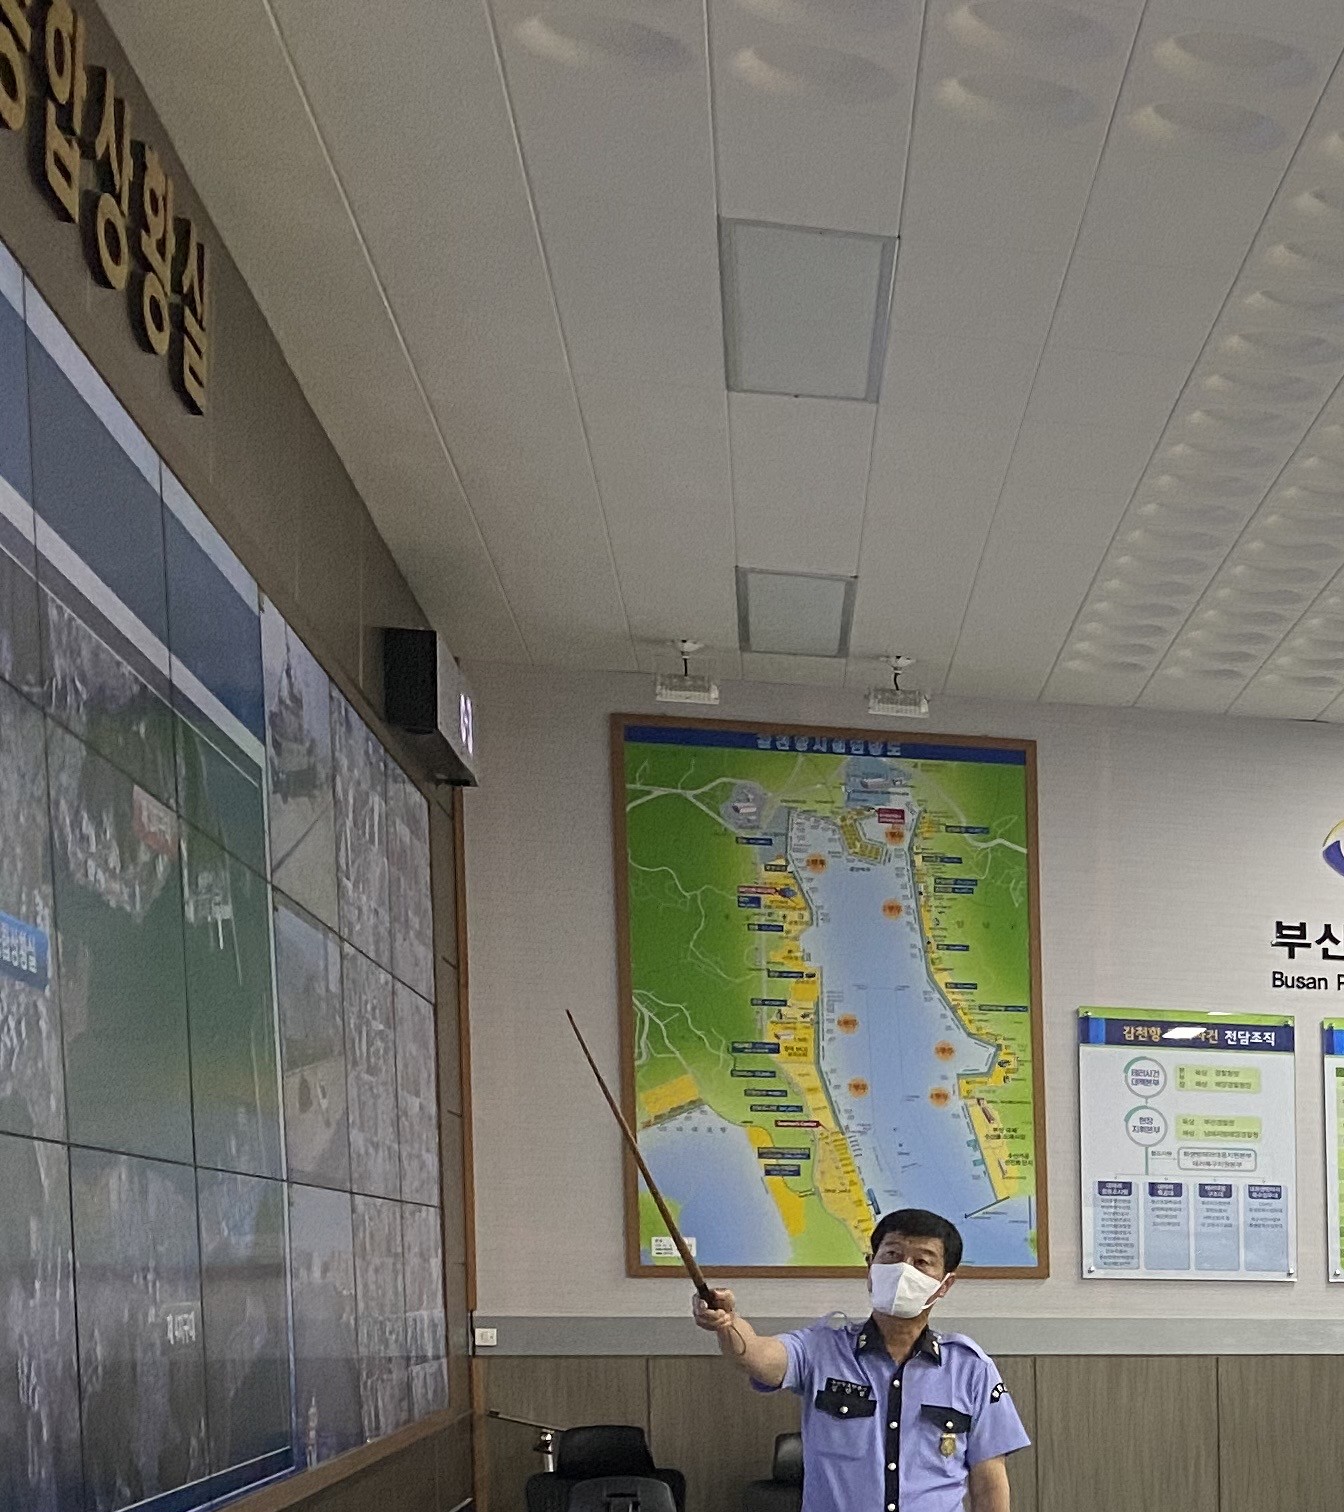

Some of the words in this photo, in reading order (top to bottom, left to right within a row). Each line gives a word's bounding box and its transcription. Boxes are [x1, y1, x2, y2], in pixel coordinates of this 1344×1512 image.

[1271, 973, 1328, 991] Busan
[1123, 1026, 1162, 1042] 감천항
[1225, 1030, 1276, 1046] 전담조직
